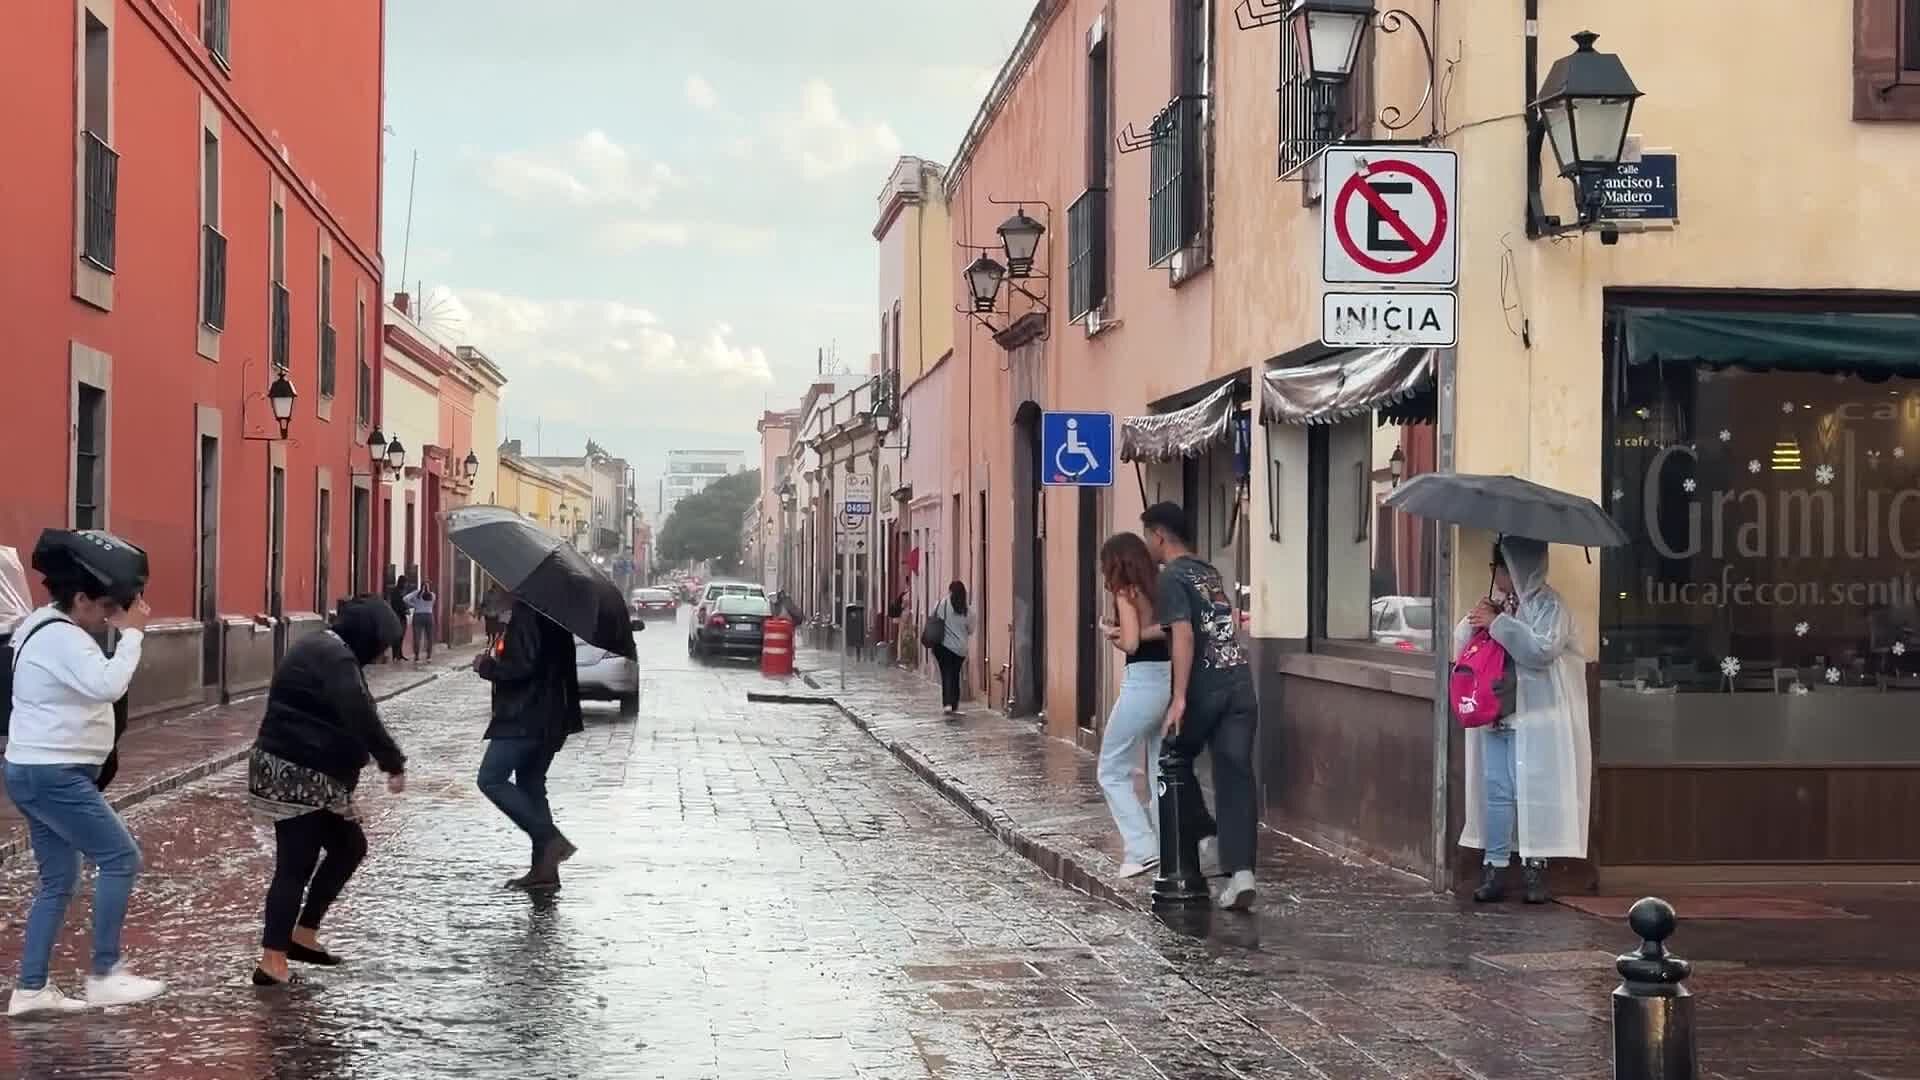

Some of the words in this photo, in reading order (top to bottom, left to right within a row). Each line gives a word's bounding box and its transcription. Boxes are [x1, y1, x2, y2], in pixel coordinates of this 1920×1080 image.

[1617, 165, 1639, 175] Calle
[1604, 191, 1652, 203] Madero
[1368, 182, 1413, 251] E
[1336, 306, 1441, 332] INICIA
